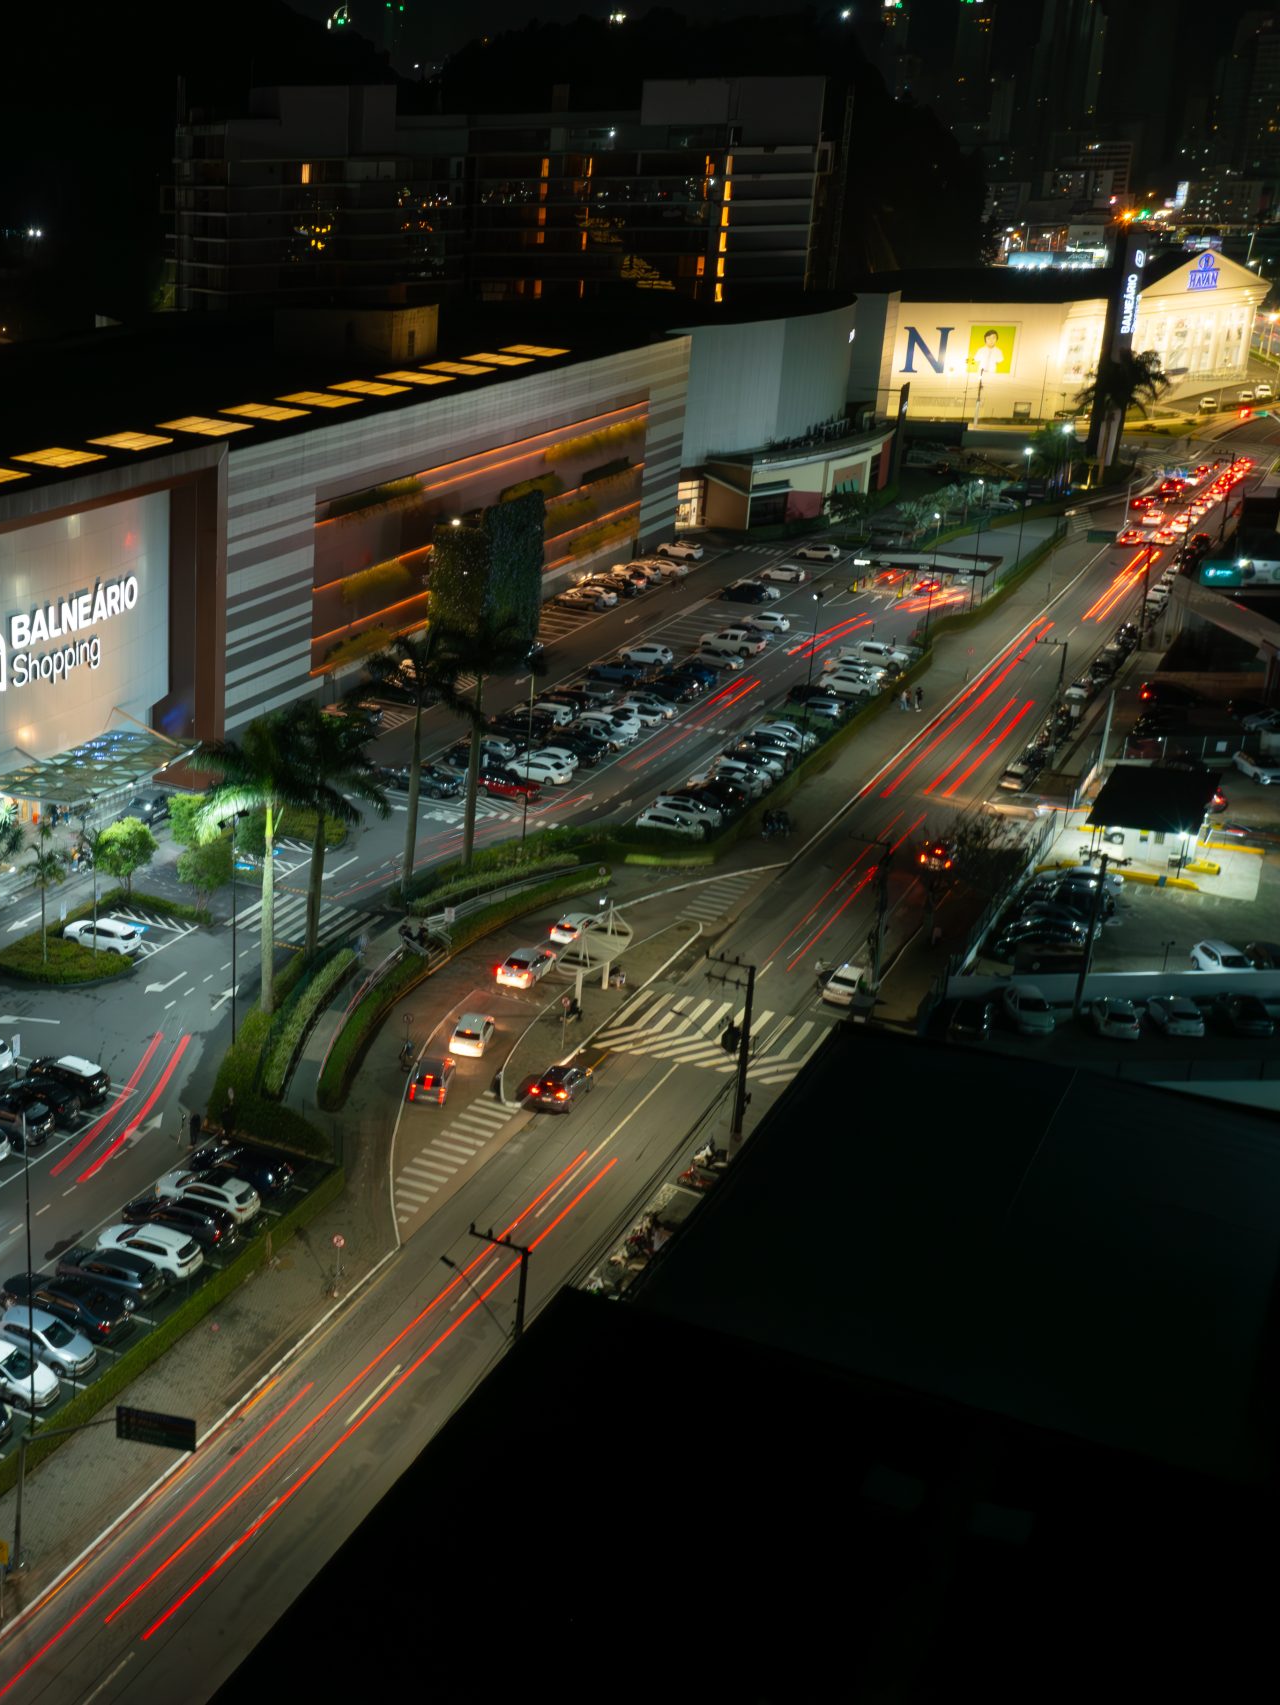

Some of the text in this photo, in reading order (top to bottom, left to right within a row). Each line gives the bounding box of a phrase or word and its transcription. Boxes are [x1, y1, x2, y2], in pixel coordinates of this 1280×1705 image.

[1121, 273, 1138, 334] BALNEÁRIO
[1187, 270, 1218, 288] HAVAN
[11, 576, 138, 650] BALNEÁRIO
[12, 637, 101, 688] Shopping
